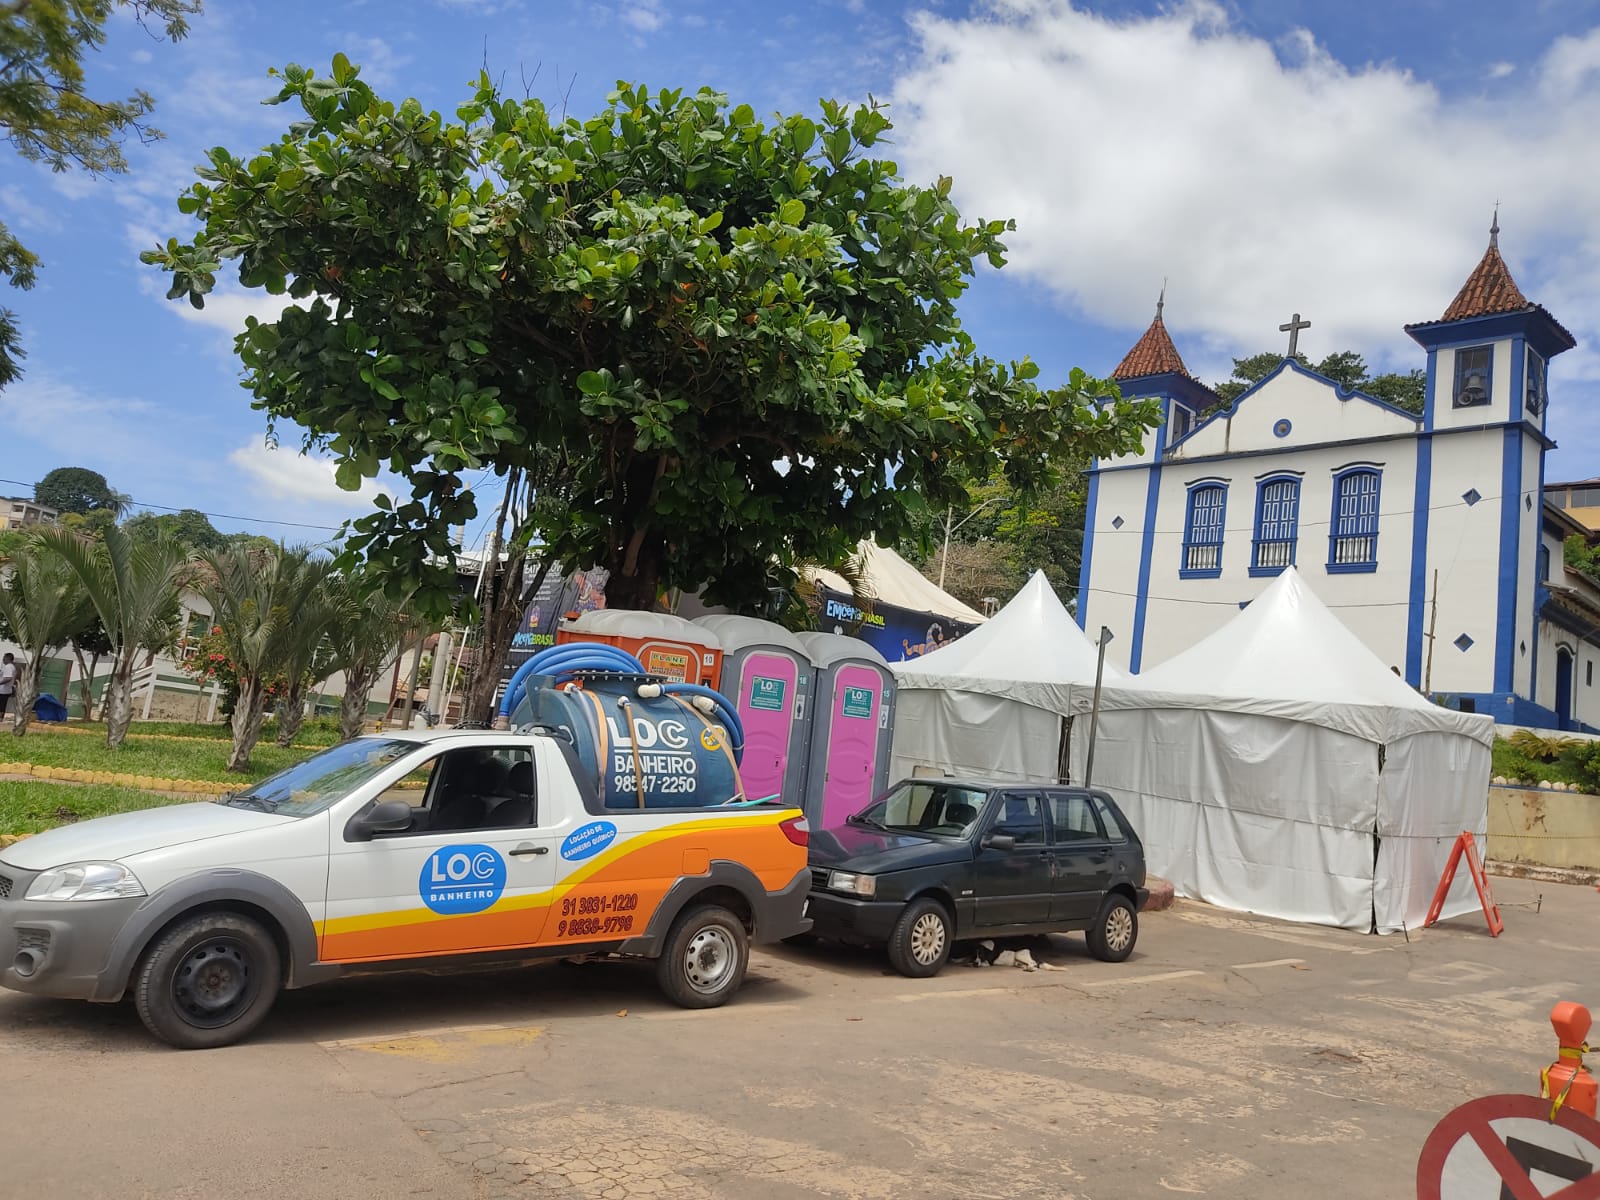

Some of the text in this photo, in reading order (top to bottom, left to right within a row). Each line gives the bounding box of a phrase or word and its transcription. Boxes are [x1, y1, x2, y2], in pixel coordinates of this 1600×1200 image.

[652, 653, 686, 664] PLANE
[705, 655, 713, 665] 10
[606, 716, 689, 749] LOC
[613, 755, 697, 775] BANHEIRO
[613, 775, 697, 793] 98547-2250
[569, 824, 603, 845] LOCAÇÃO DE
[563, 841, 592, 858] BANHEIRO
[431, 852, 496, 882] LOC
[430, 889, 494, 902] BANHEIRO
[562, 893, 639, 917] 31 3831-1220
[557, 915, 634, 938] 9 8838-9798
